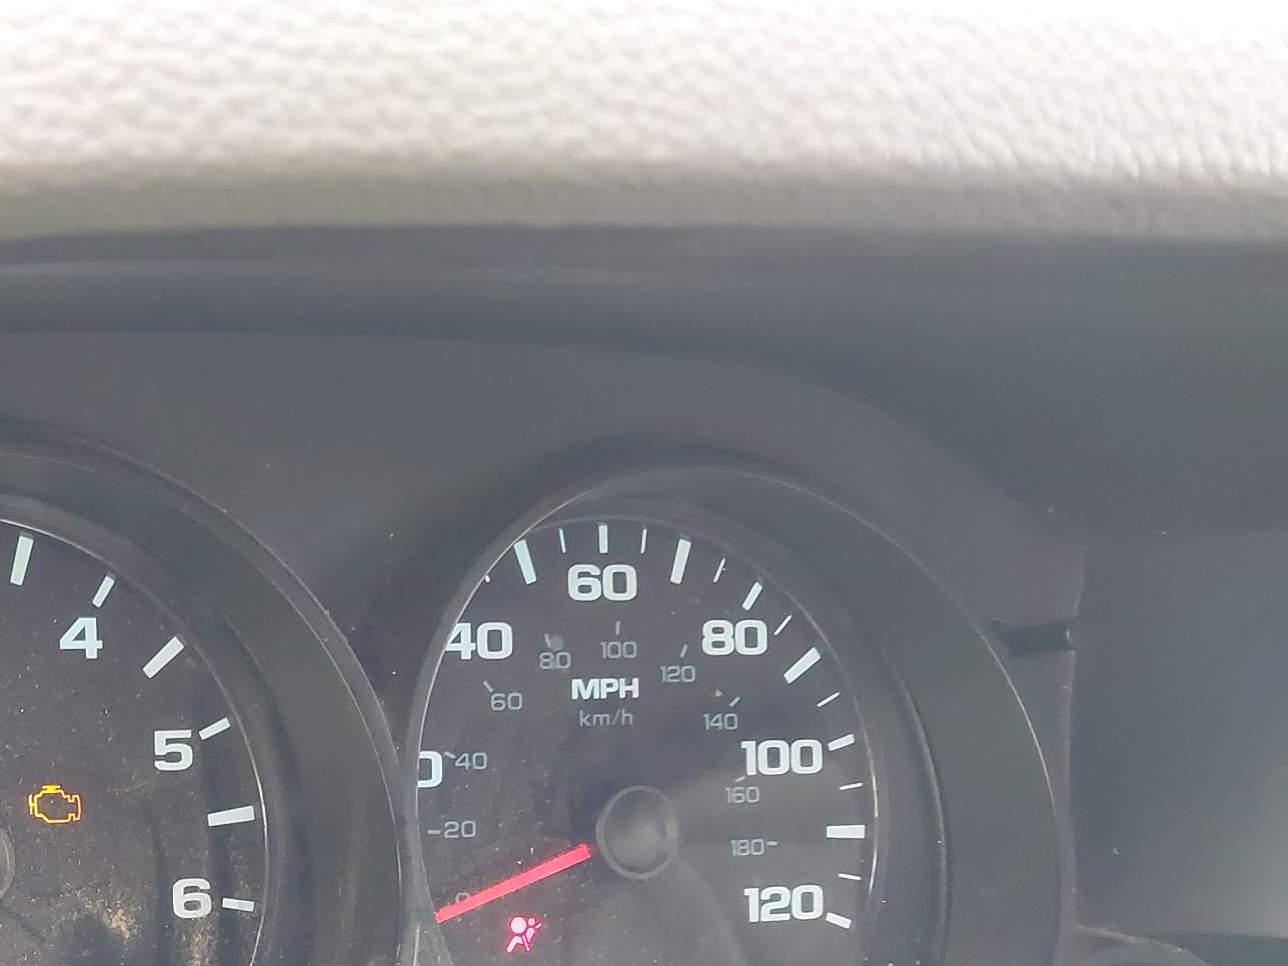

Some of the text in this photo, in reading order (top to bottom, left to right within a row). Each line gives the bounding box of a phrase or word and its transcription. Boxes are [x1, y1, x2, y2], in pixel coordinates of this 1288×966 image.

[567, 564, 637, 601] 60
[59, 617, 103, 659] 4
[445, 622, 513, 660] 40
[701, 620, 767, 655] 80
[600, 641, 637, 659] 100
[539, 652, 571, 670] 80
[660, 666, 696, 683] 120
[571, 678, 639, 699] MPH
[490, 693, 523, 710] 60
[578, 709, 633, 728] km/h
[703, 713, 738, 731] 140
[154, 729, 194, 771] 5
[741, 740, 823, 775] 100
[417, 751, 443, 788] 0
[455, 752, 488, 770] 40
[725, 787, 760, 803] 160
[444, 820, 476, 838] 20
[730, 839, 765, 856] 180
[172, 878, 212, 918] 6
[744, 885, 823, 922] 120
